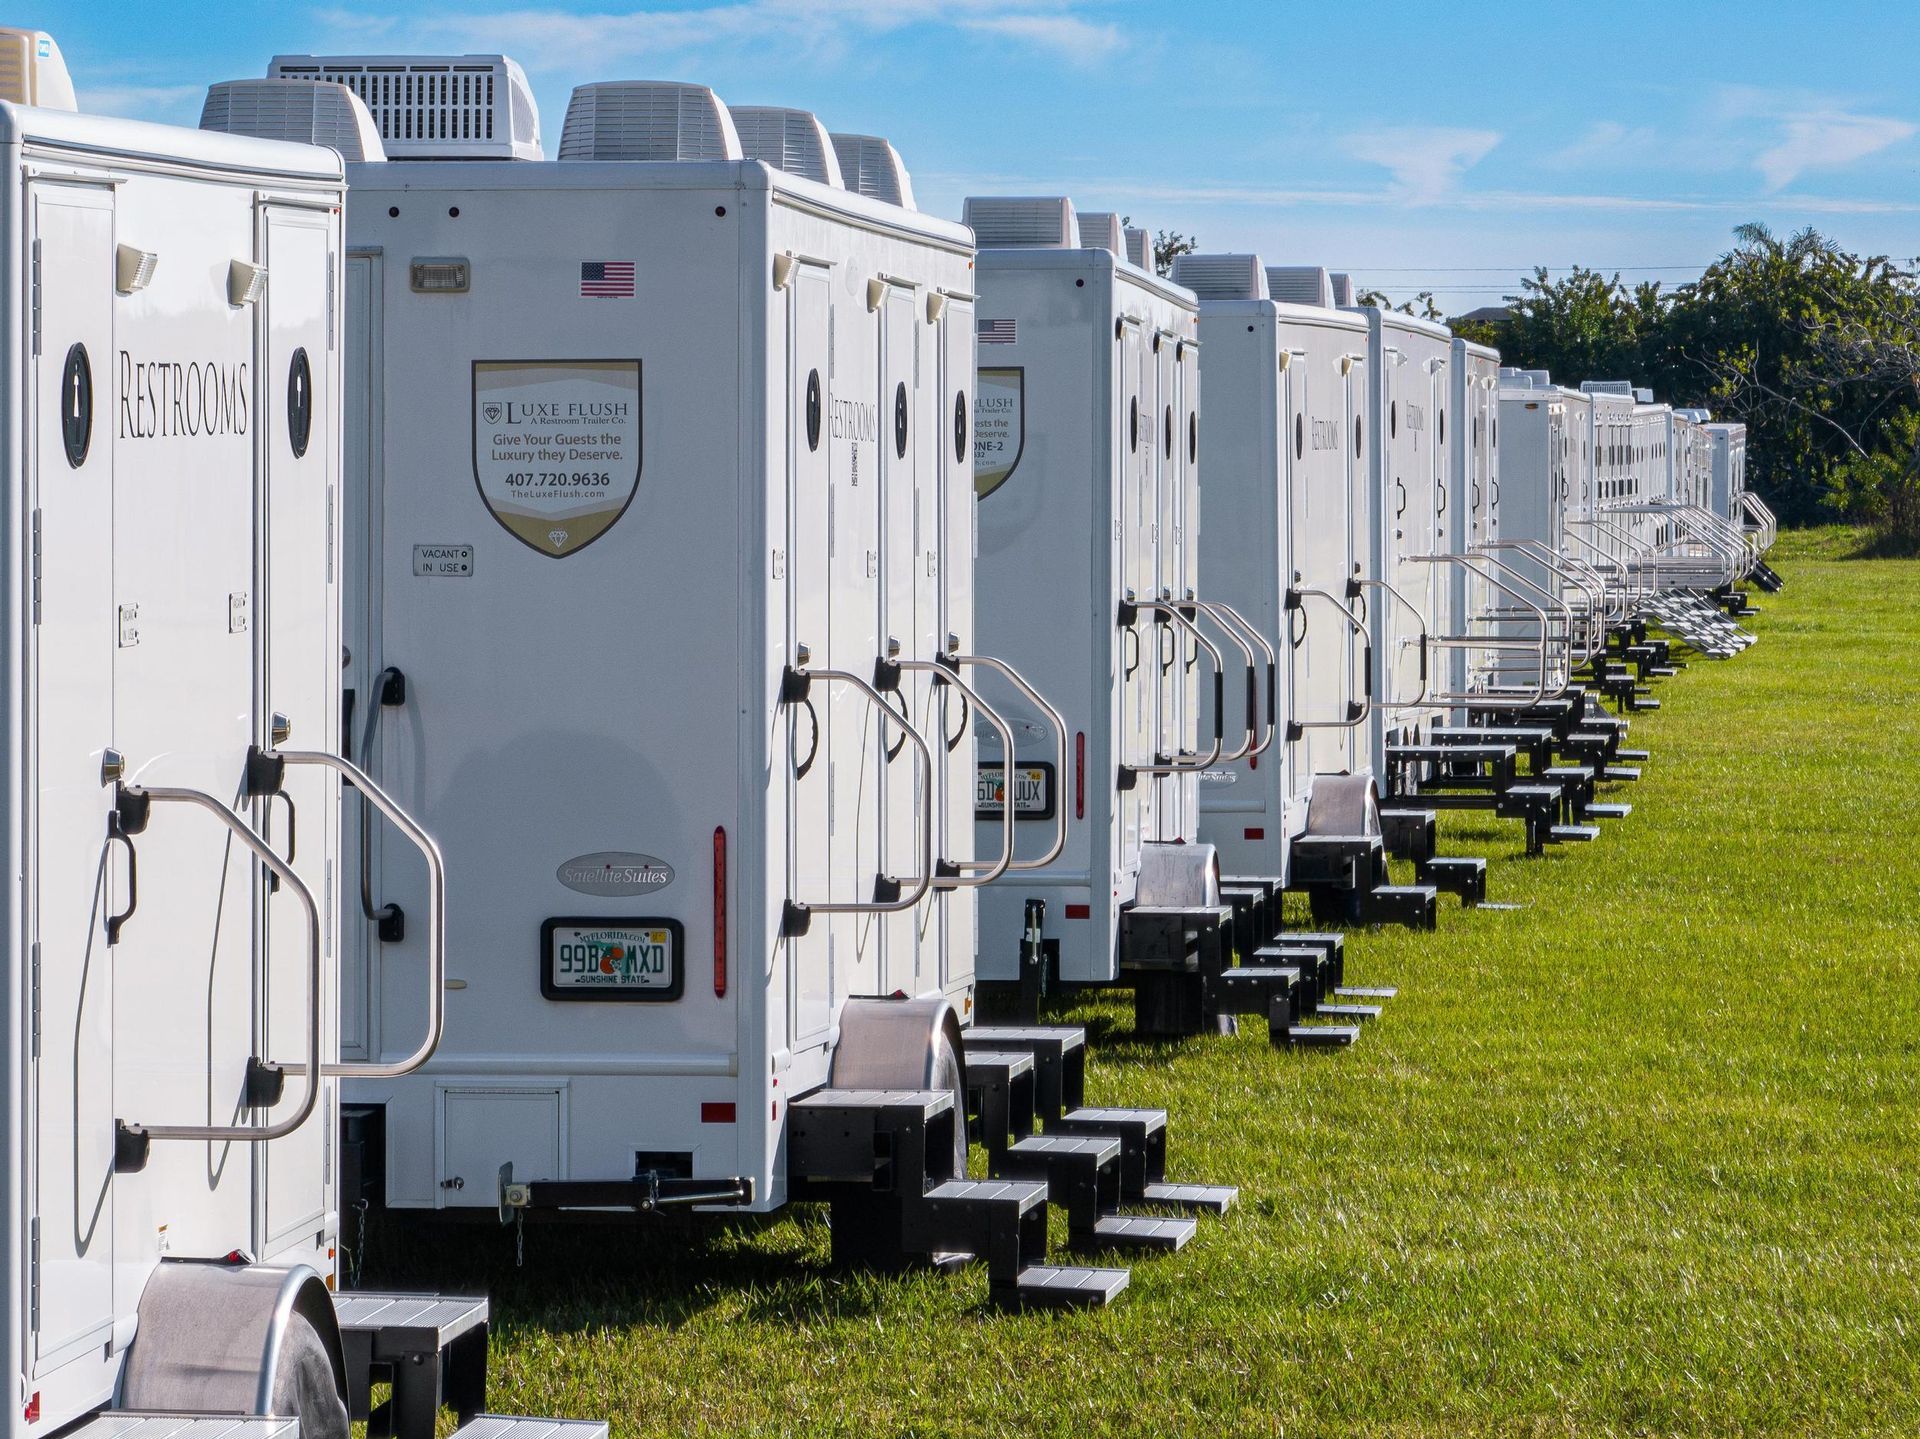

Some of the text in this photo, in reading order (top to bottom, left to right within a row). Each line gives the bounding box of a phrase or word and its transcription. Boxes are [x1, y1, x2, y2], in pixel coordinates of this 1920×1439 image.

[119, 350, 248, 439] RESTROOMS
[506, 402, 627, 424] LUXE FLUSH
[829, 392, 877, 442] RESTROOMS
[540, 417, 580, 425] Restroom
[581, 417, 609, 425] Trailer
[611, 417, 626, 425] Co.
[975, 419, 1009, 428] ests the
[493, 433, 621, 446] Give Your Guests the
[491, 449, 623, 464] Luxury they Deserve.
[505, 473, 611, 487] 407.720.9636
[511, 489, 605, 498] TheLuxeFlush.com
[421, 549, 459, 558] VACANT
[422, 563, 459, 572] IN USE
[580, 975, 646, 984] SUNSHINE STATE
